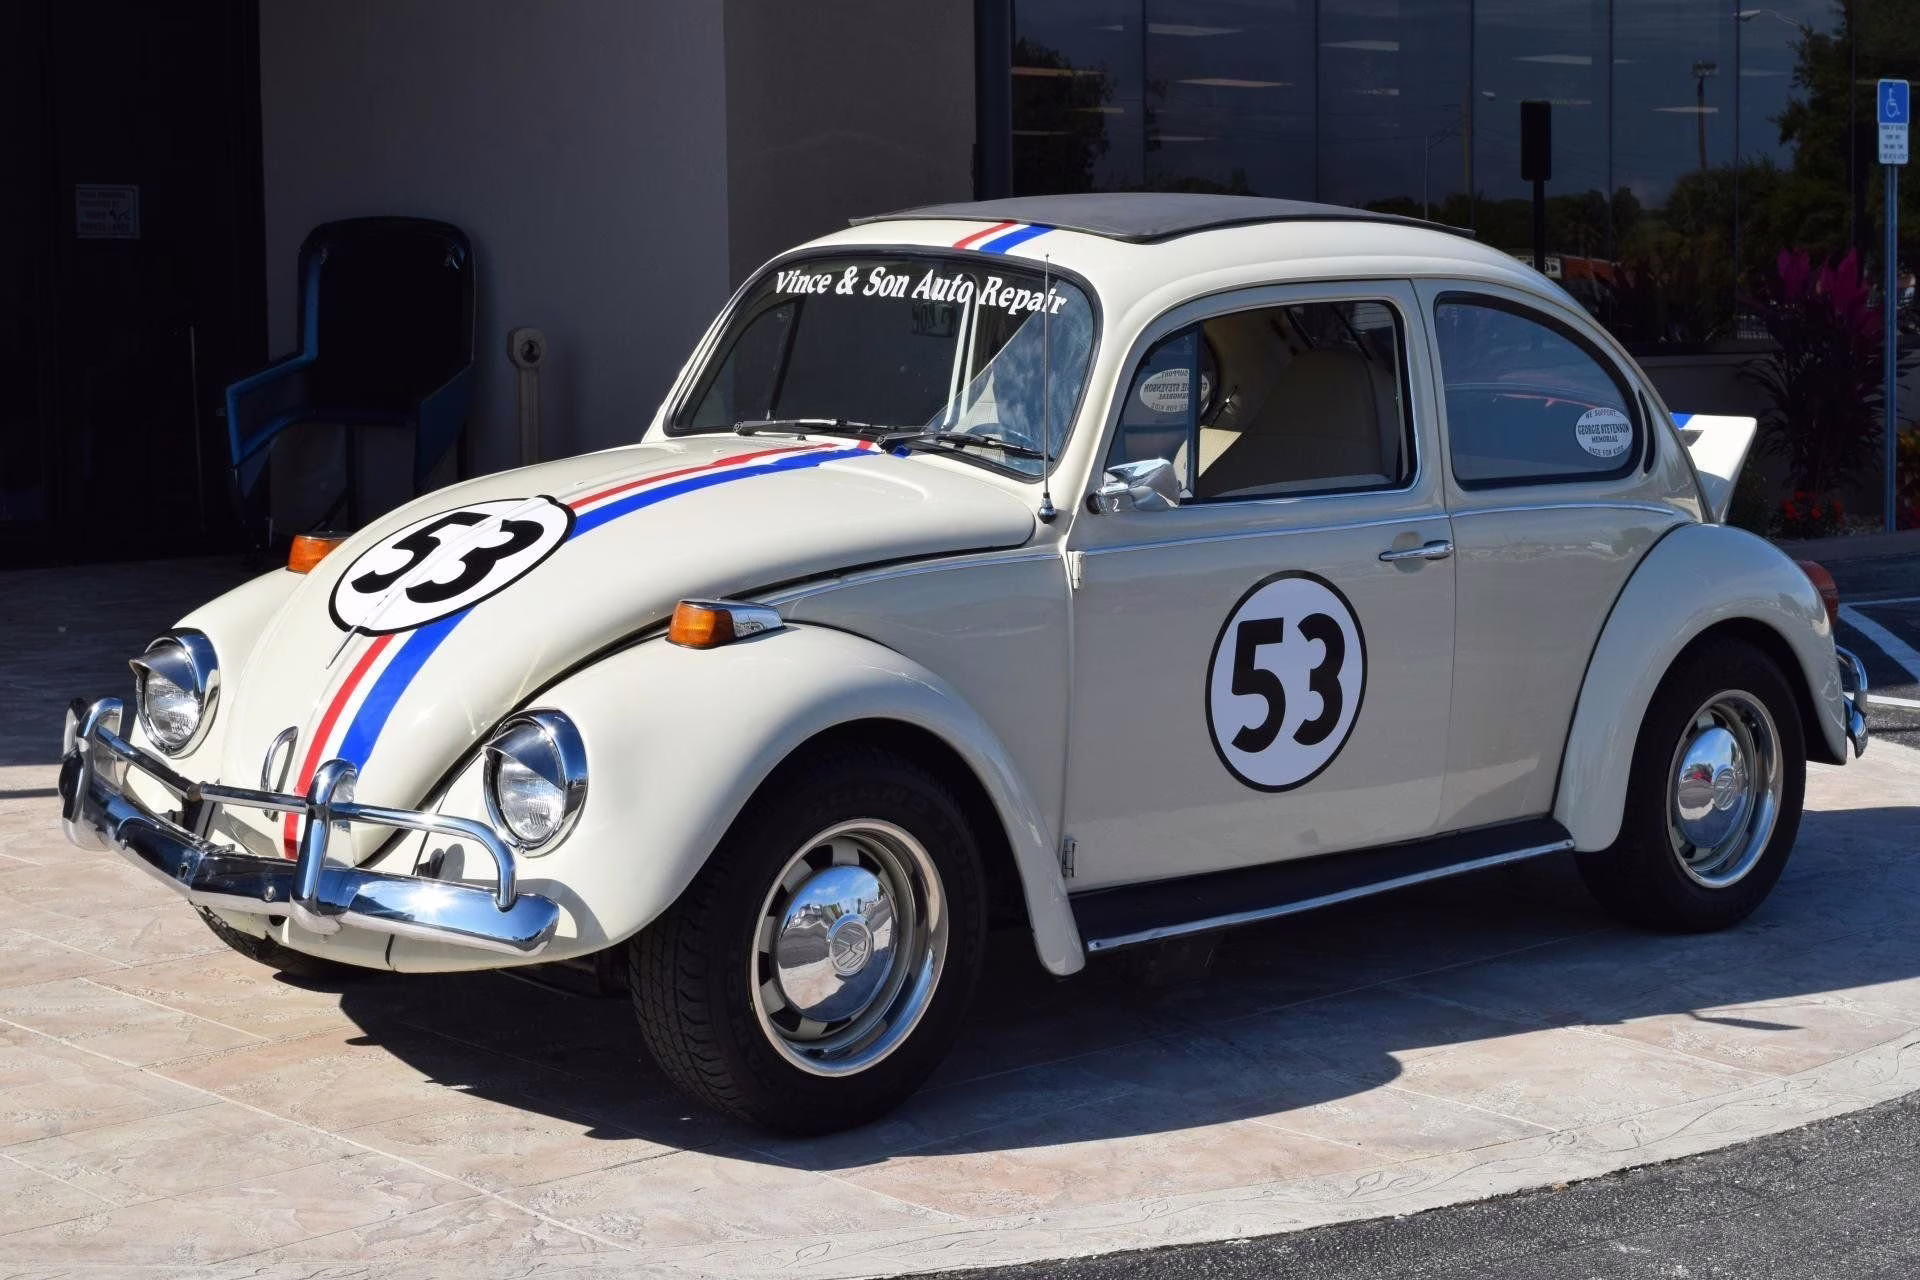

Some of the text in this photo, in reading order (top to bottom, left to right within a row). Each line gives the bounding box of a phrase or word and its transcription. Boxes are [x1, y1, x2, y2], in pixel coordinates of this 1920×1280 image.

[775, 266, 1067, 315] Vince & Son Auto Repair
[1601, 423, 1630, 434] STEVENSON
[351, 511, 545, 604] 53
[1231, 612, 1346, 754] 53
